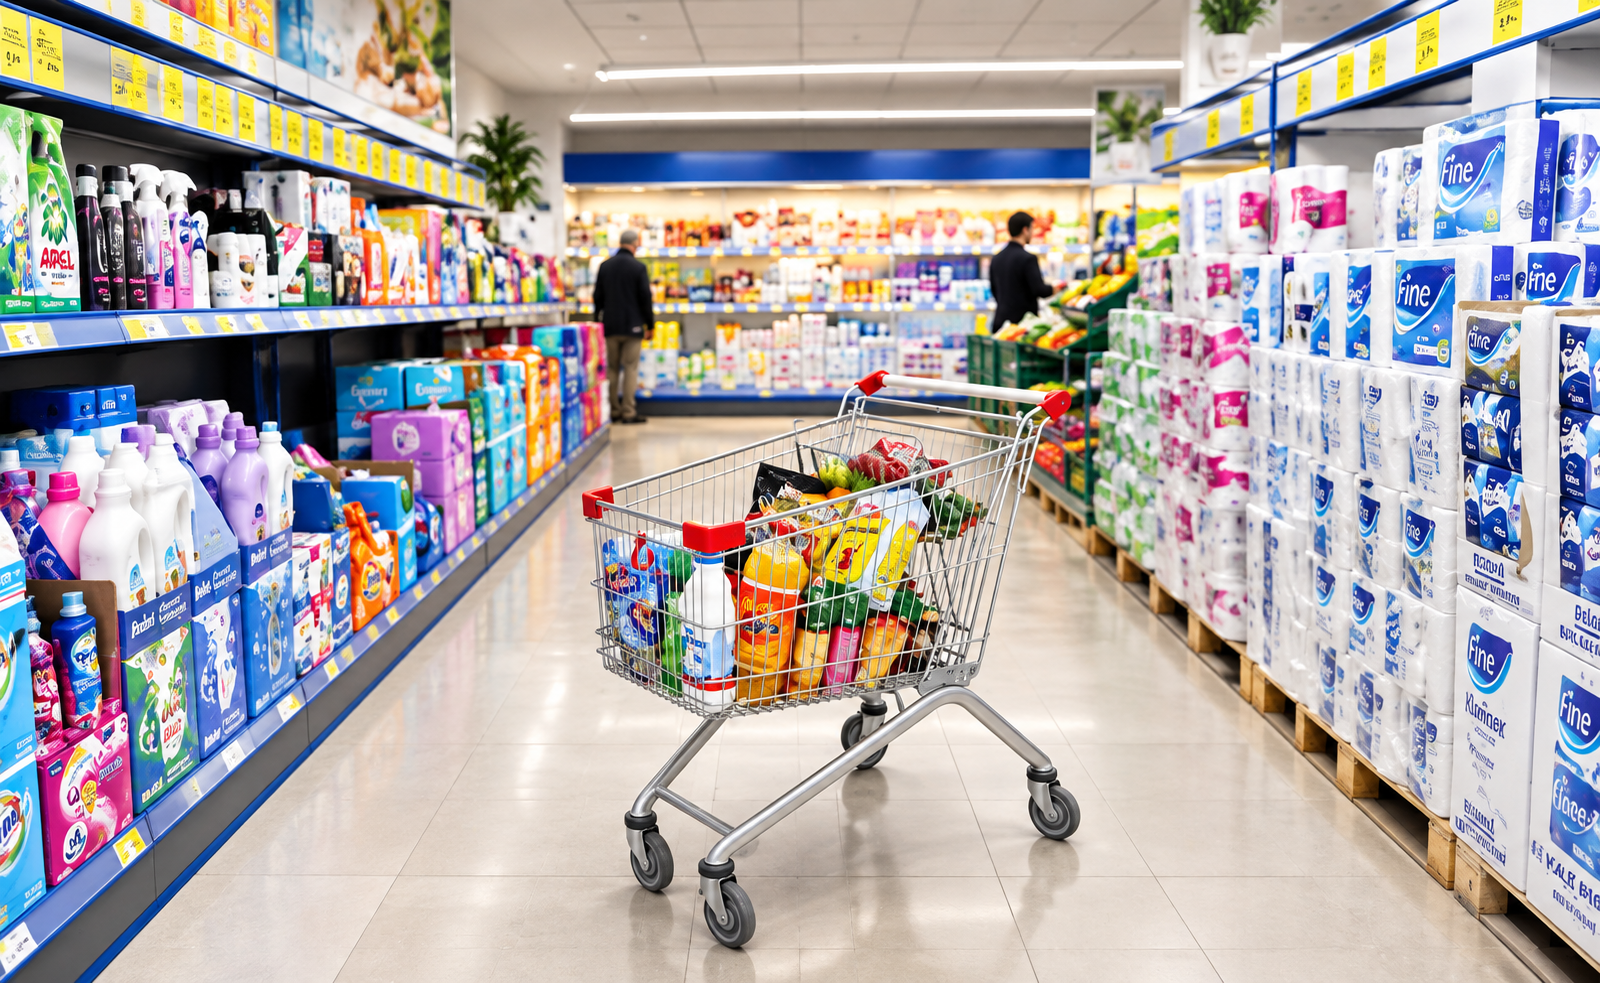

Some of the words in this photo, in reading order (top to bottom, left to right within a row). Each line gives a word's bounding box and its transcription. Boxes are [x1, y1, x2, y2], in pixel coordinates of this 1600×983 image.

[1441, 153, 1474, 186] Fine
[1396, 273, 1431, 307] Fine
[1468, 634, 1495, 676] Fine
[1559, 690, 1592, 737] Fine
